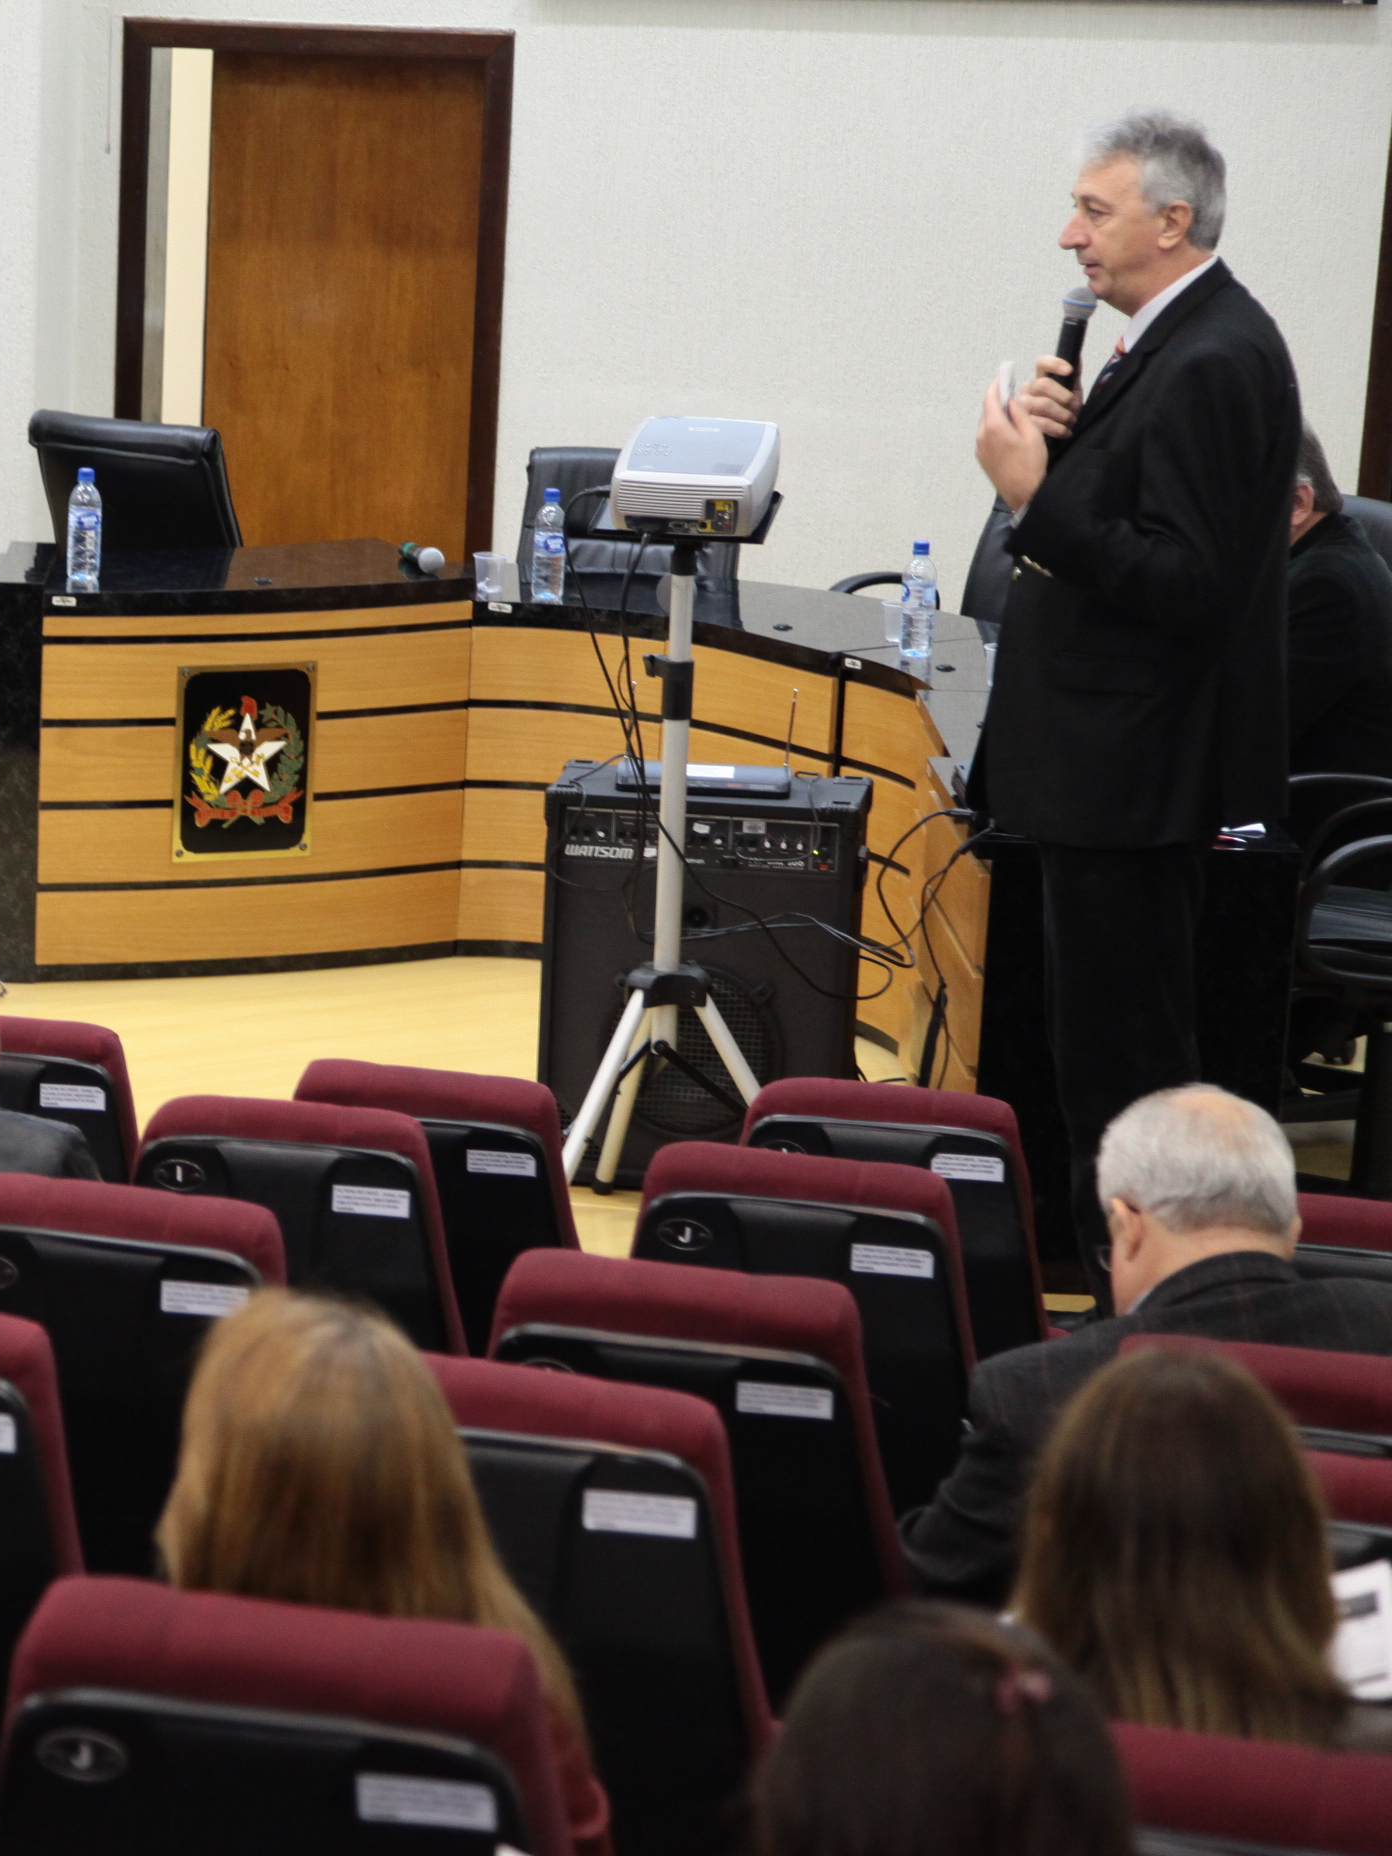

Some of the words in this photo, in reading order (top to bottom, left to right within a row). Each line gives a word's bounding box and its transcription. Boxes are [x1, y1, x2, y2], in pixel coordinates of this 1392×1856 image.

[564, 844, 634, 859] WATTSOM
[678, 1226, 691, 1243] J
[70, 1743, 91, 1769] J
